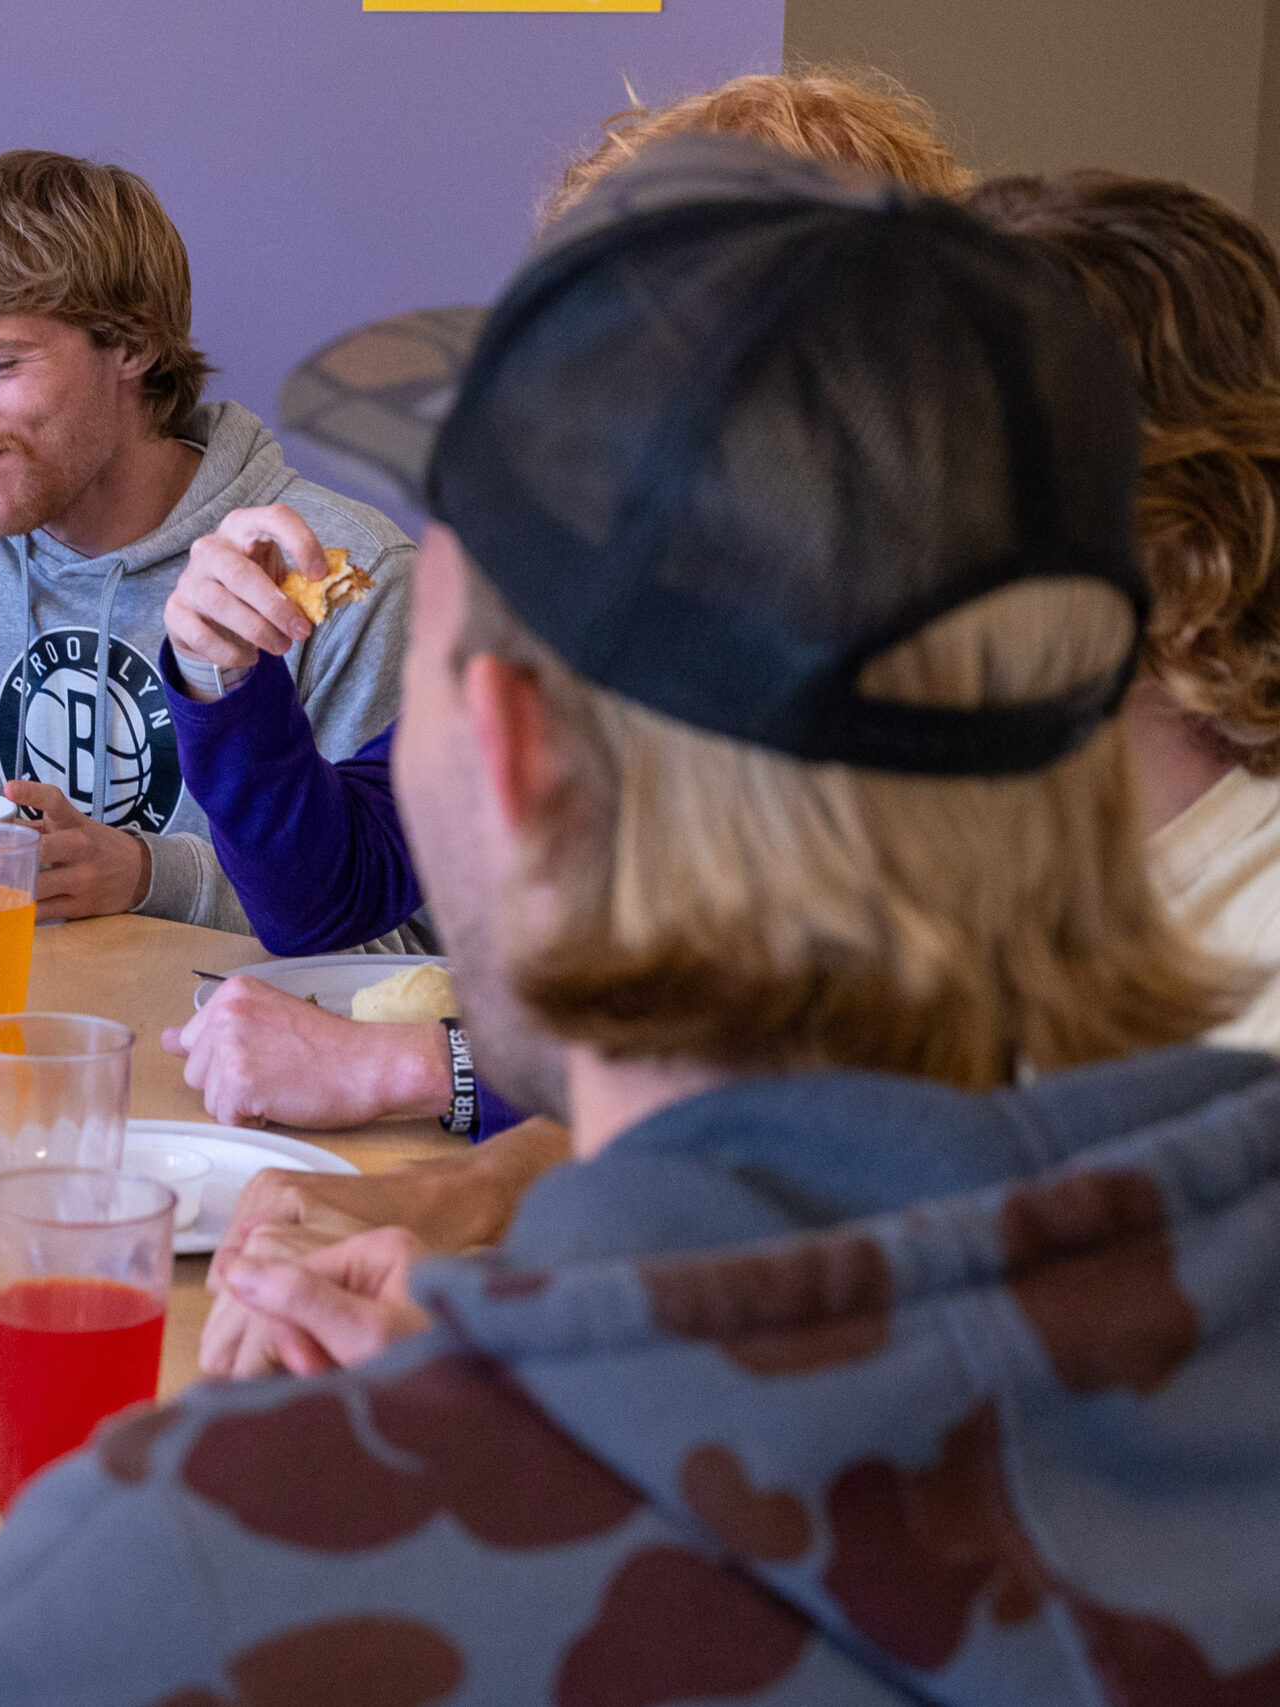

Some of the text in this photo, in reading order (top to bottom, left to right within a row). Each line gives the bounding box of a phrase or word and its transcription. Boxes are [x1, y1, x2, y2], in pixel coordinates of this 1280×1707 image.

[11, 636, 172, 730] BROOLYN
[448, 1028, 474, 1073] TAKES
[454, 1074, 475, 1092] IT
